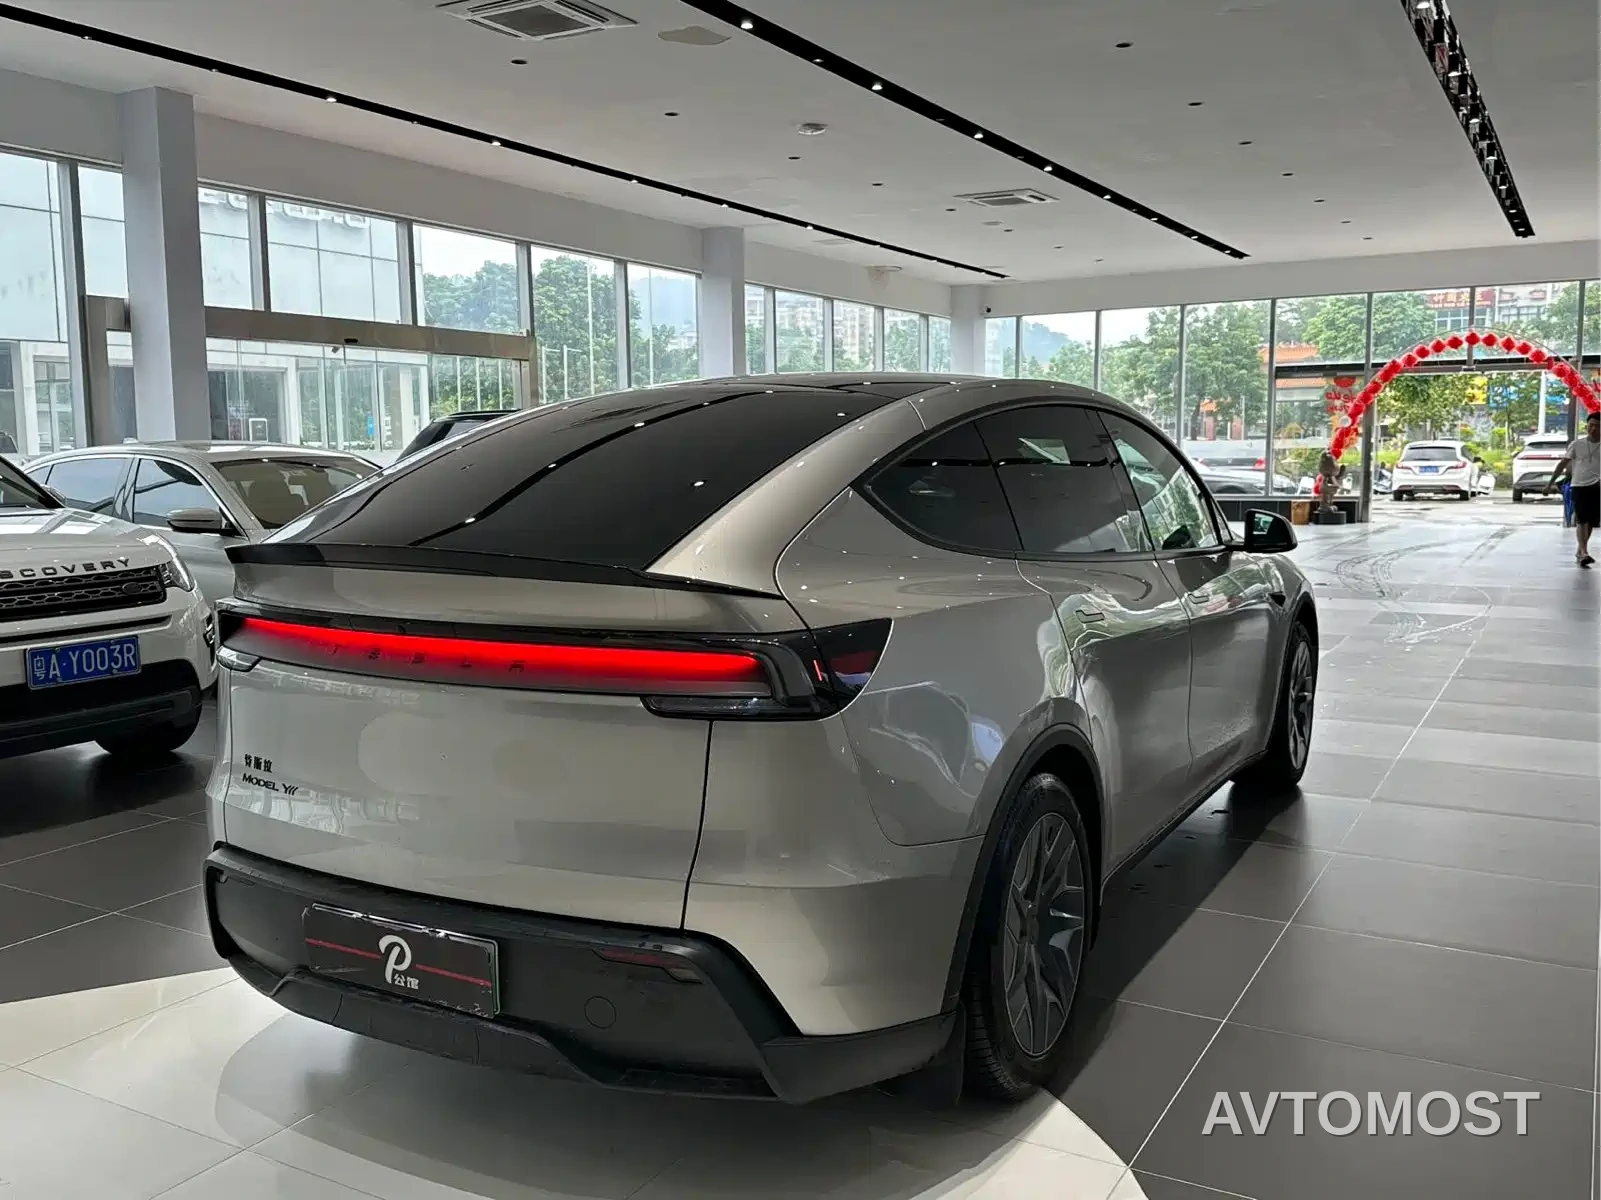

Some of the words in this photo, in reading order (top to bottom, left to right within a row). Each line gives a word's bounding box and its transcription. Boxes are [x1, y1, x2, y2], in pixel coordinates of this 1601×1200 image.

[244, 753, 273, 773] 特斯拉
[242, 772, 279, 792] MODEL
[393, 973, 419, 990] 公馆
